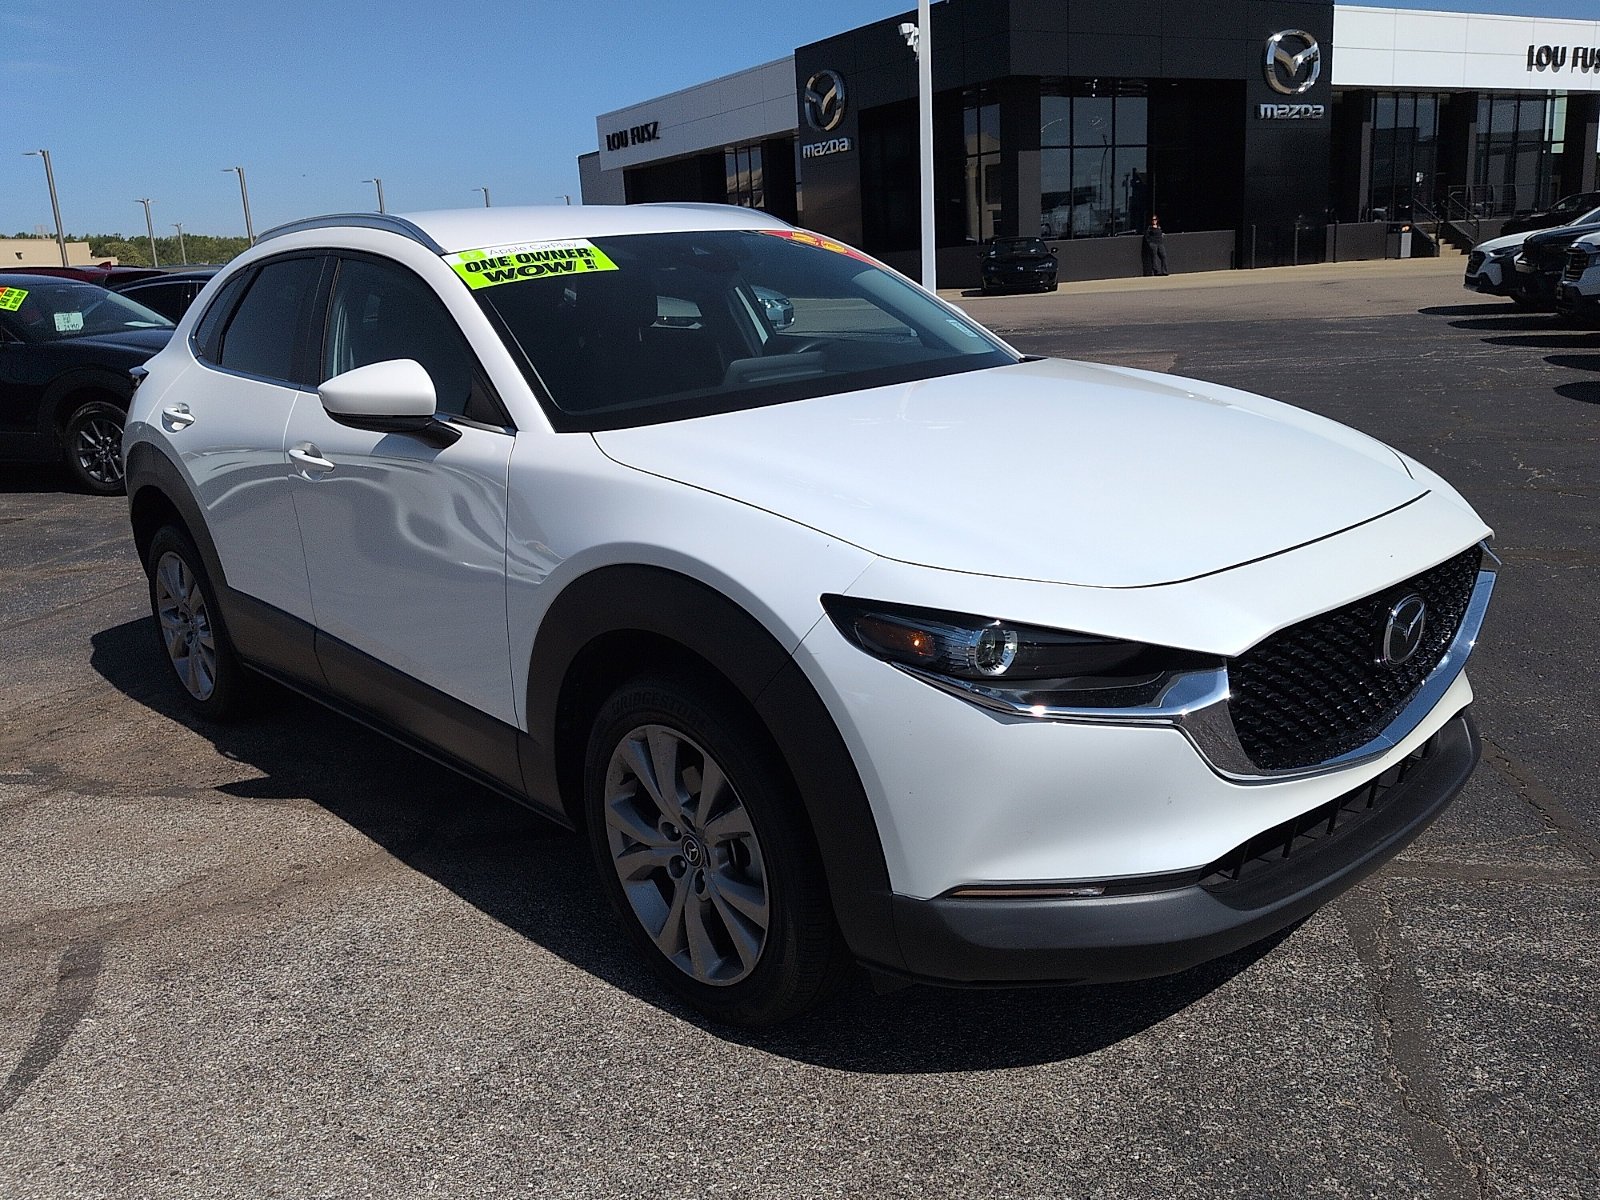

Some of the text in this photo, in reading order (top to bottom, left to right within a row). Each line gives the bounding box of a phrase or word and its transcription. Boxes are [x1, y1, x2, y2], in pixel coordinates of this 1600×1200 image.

[1527, 45, 1567, 67] LOU
[1260, 103, 1325, 119] mazda
[606, 121, 660, 151] LOU FUSZ
[802, 137, 850, 159] mazda
[490, 242, 577, 255] Apple CarPlay
[465, 248, 595, 273] ONE OWNER
[482, 260, 577, 283] WOW
